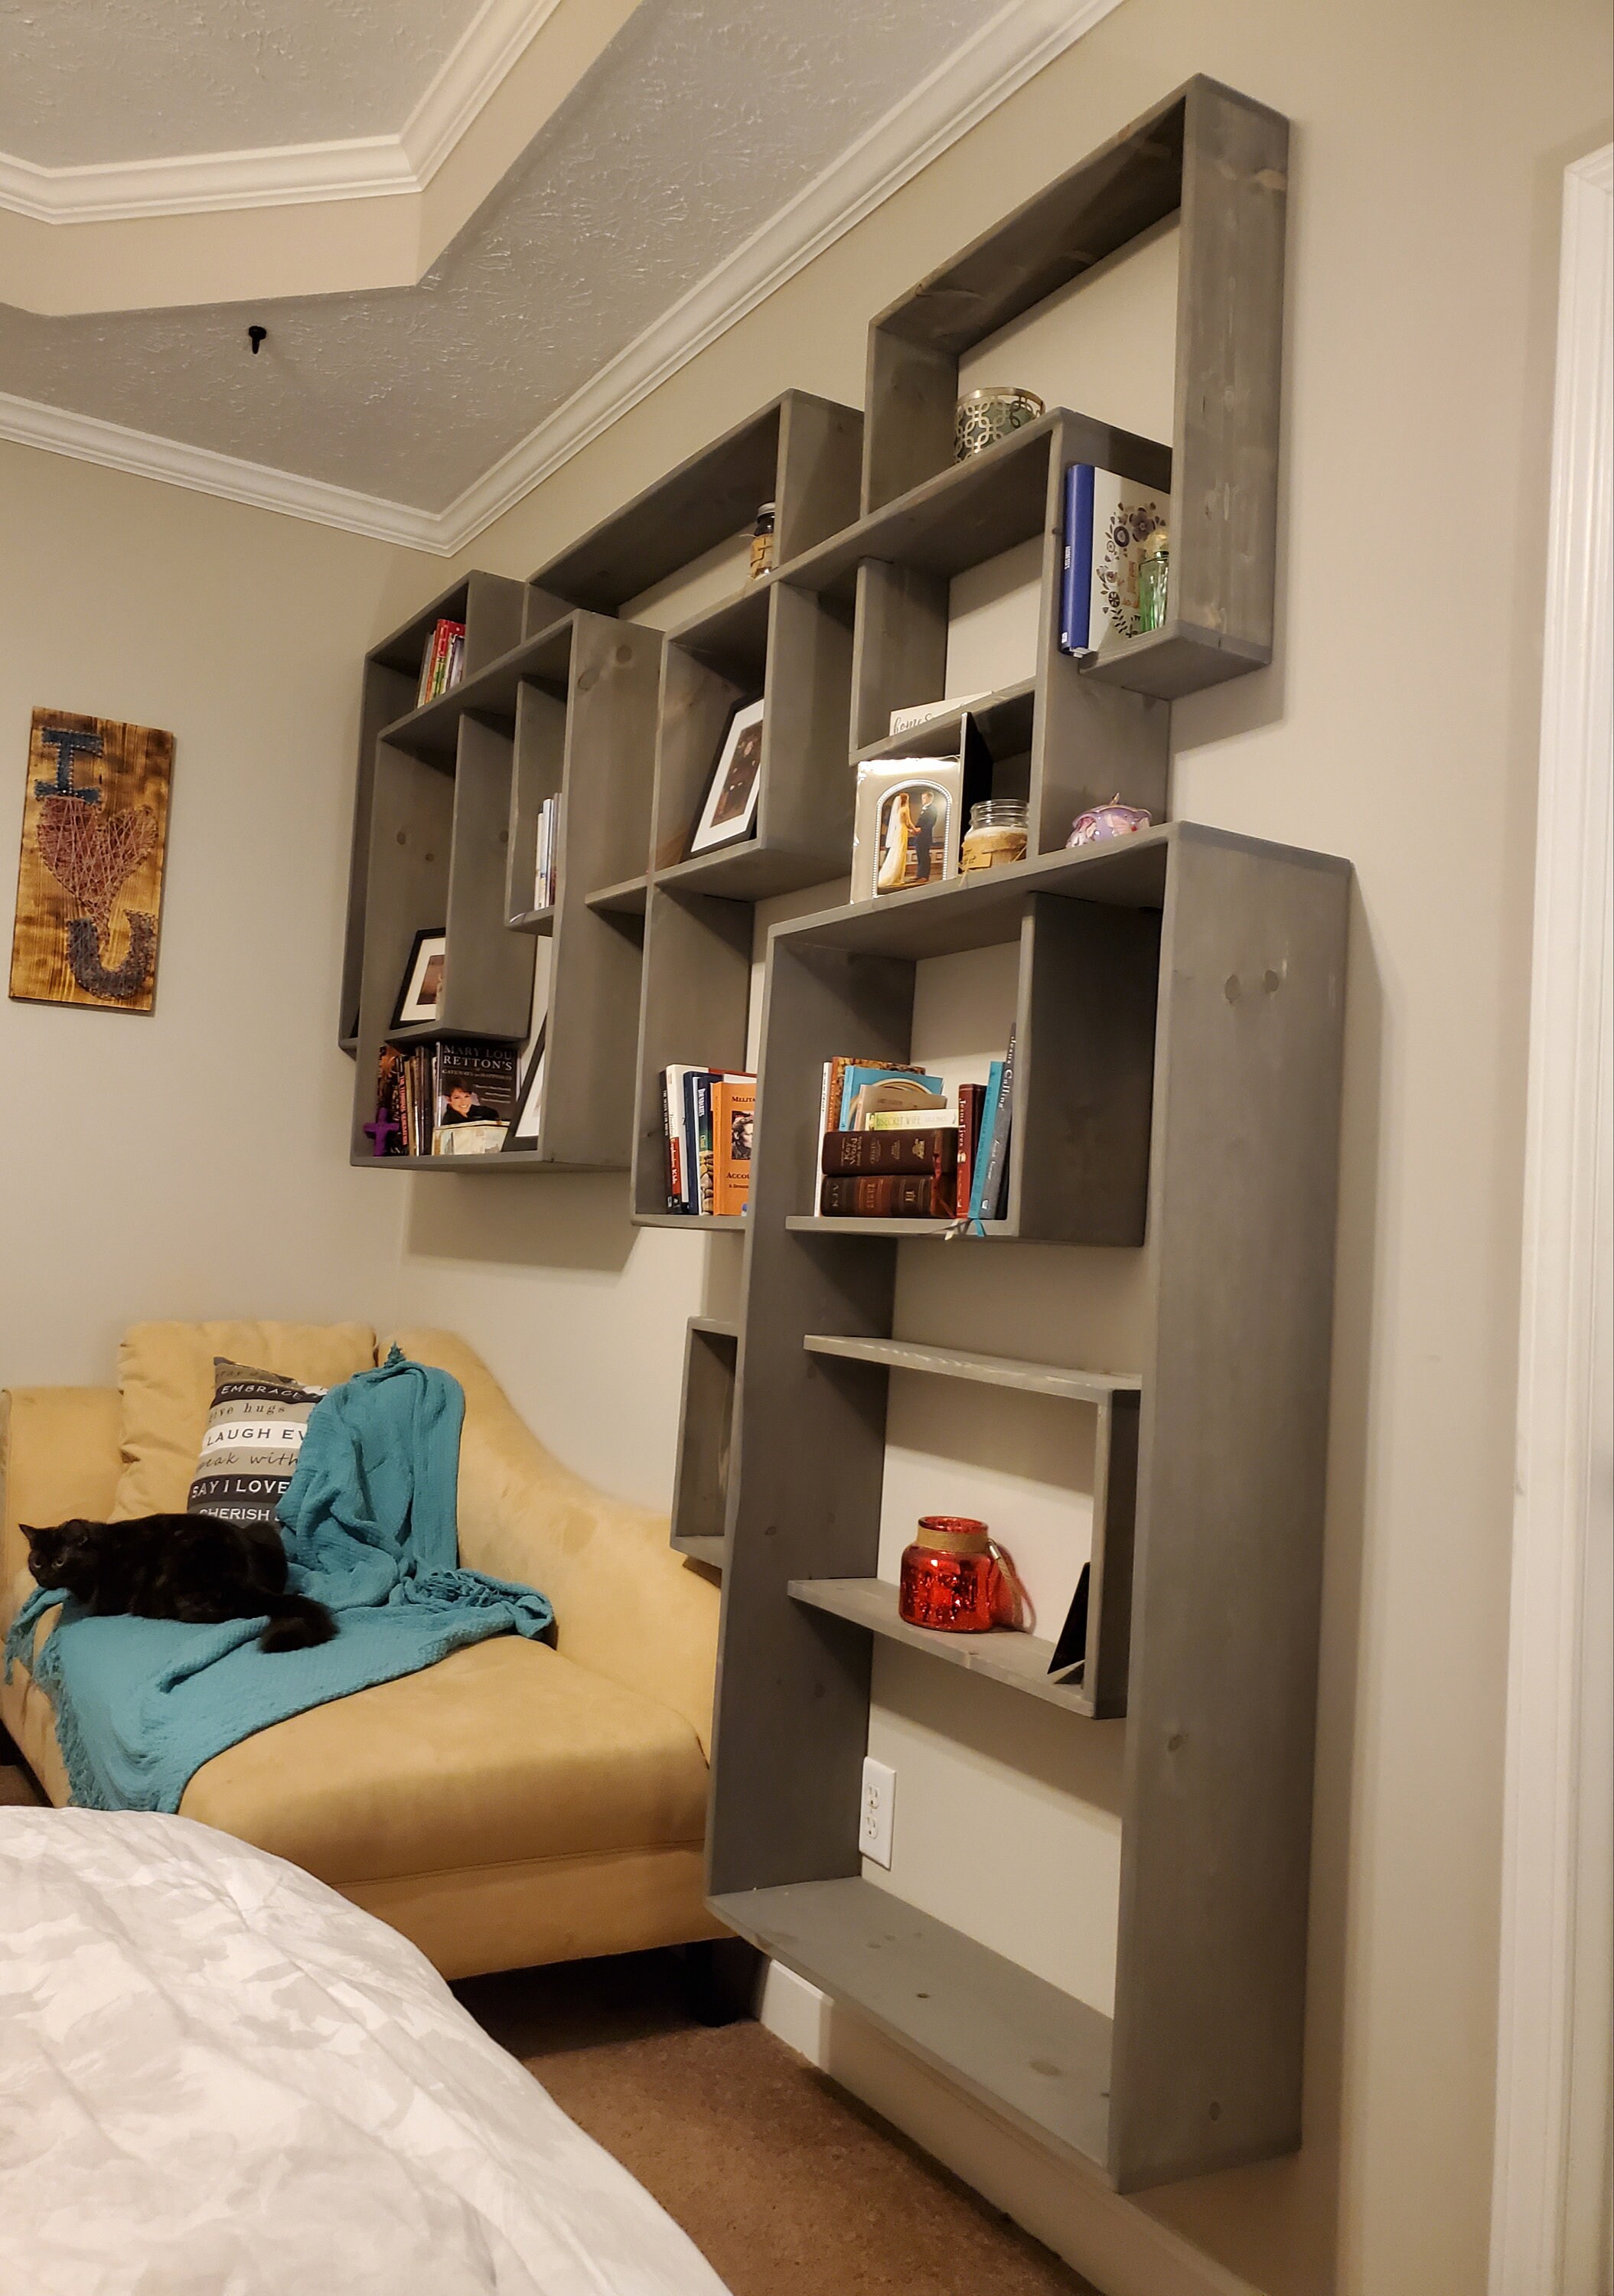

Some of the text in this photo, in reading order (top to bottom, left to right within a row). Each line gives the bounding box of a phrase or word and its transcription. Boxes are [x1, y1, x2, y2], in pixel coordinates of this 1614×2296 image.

[34, 727, 104, 804] I
[66, 909, 159, 1001] U
[443, 1044, 513, 1061] MARY LOU
[443, 1055, 513, 1071] RETTON'S
[999, 1035, 1016, 1109] Jesus Calling
[849, 1137, 858, 1166] Word
[221, 1383, 303, 1401] EMBRACE
[243, 1402, 286, 1415] hugs
[207, 1428, 271, 1446] LAUGH
[250, 1453, 298, 1466] with
[191, 1479, 290, 1499] SAY I LOVE
